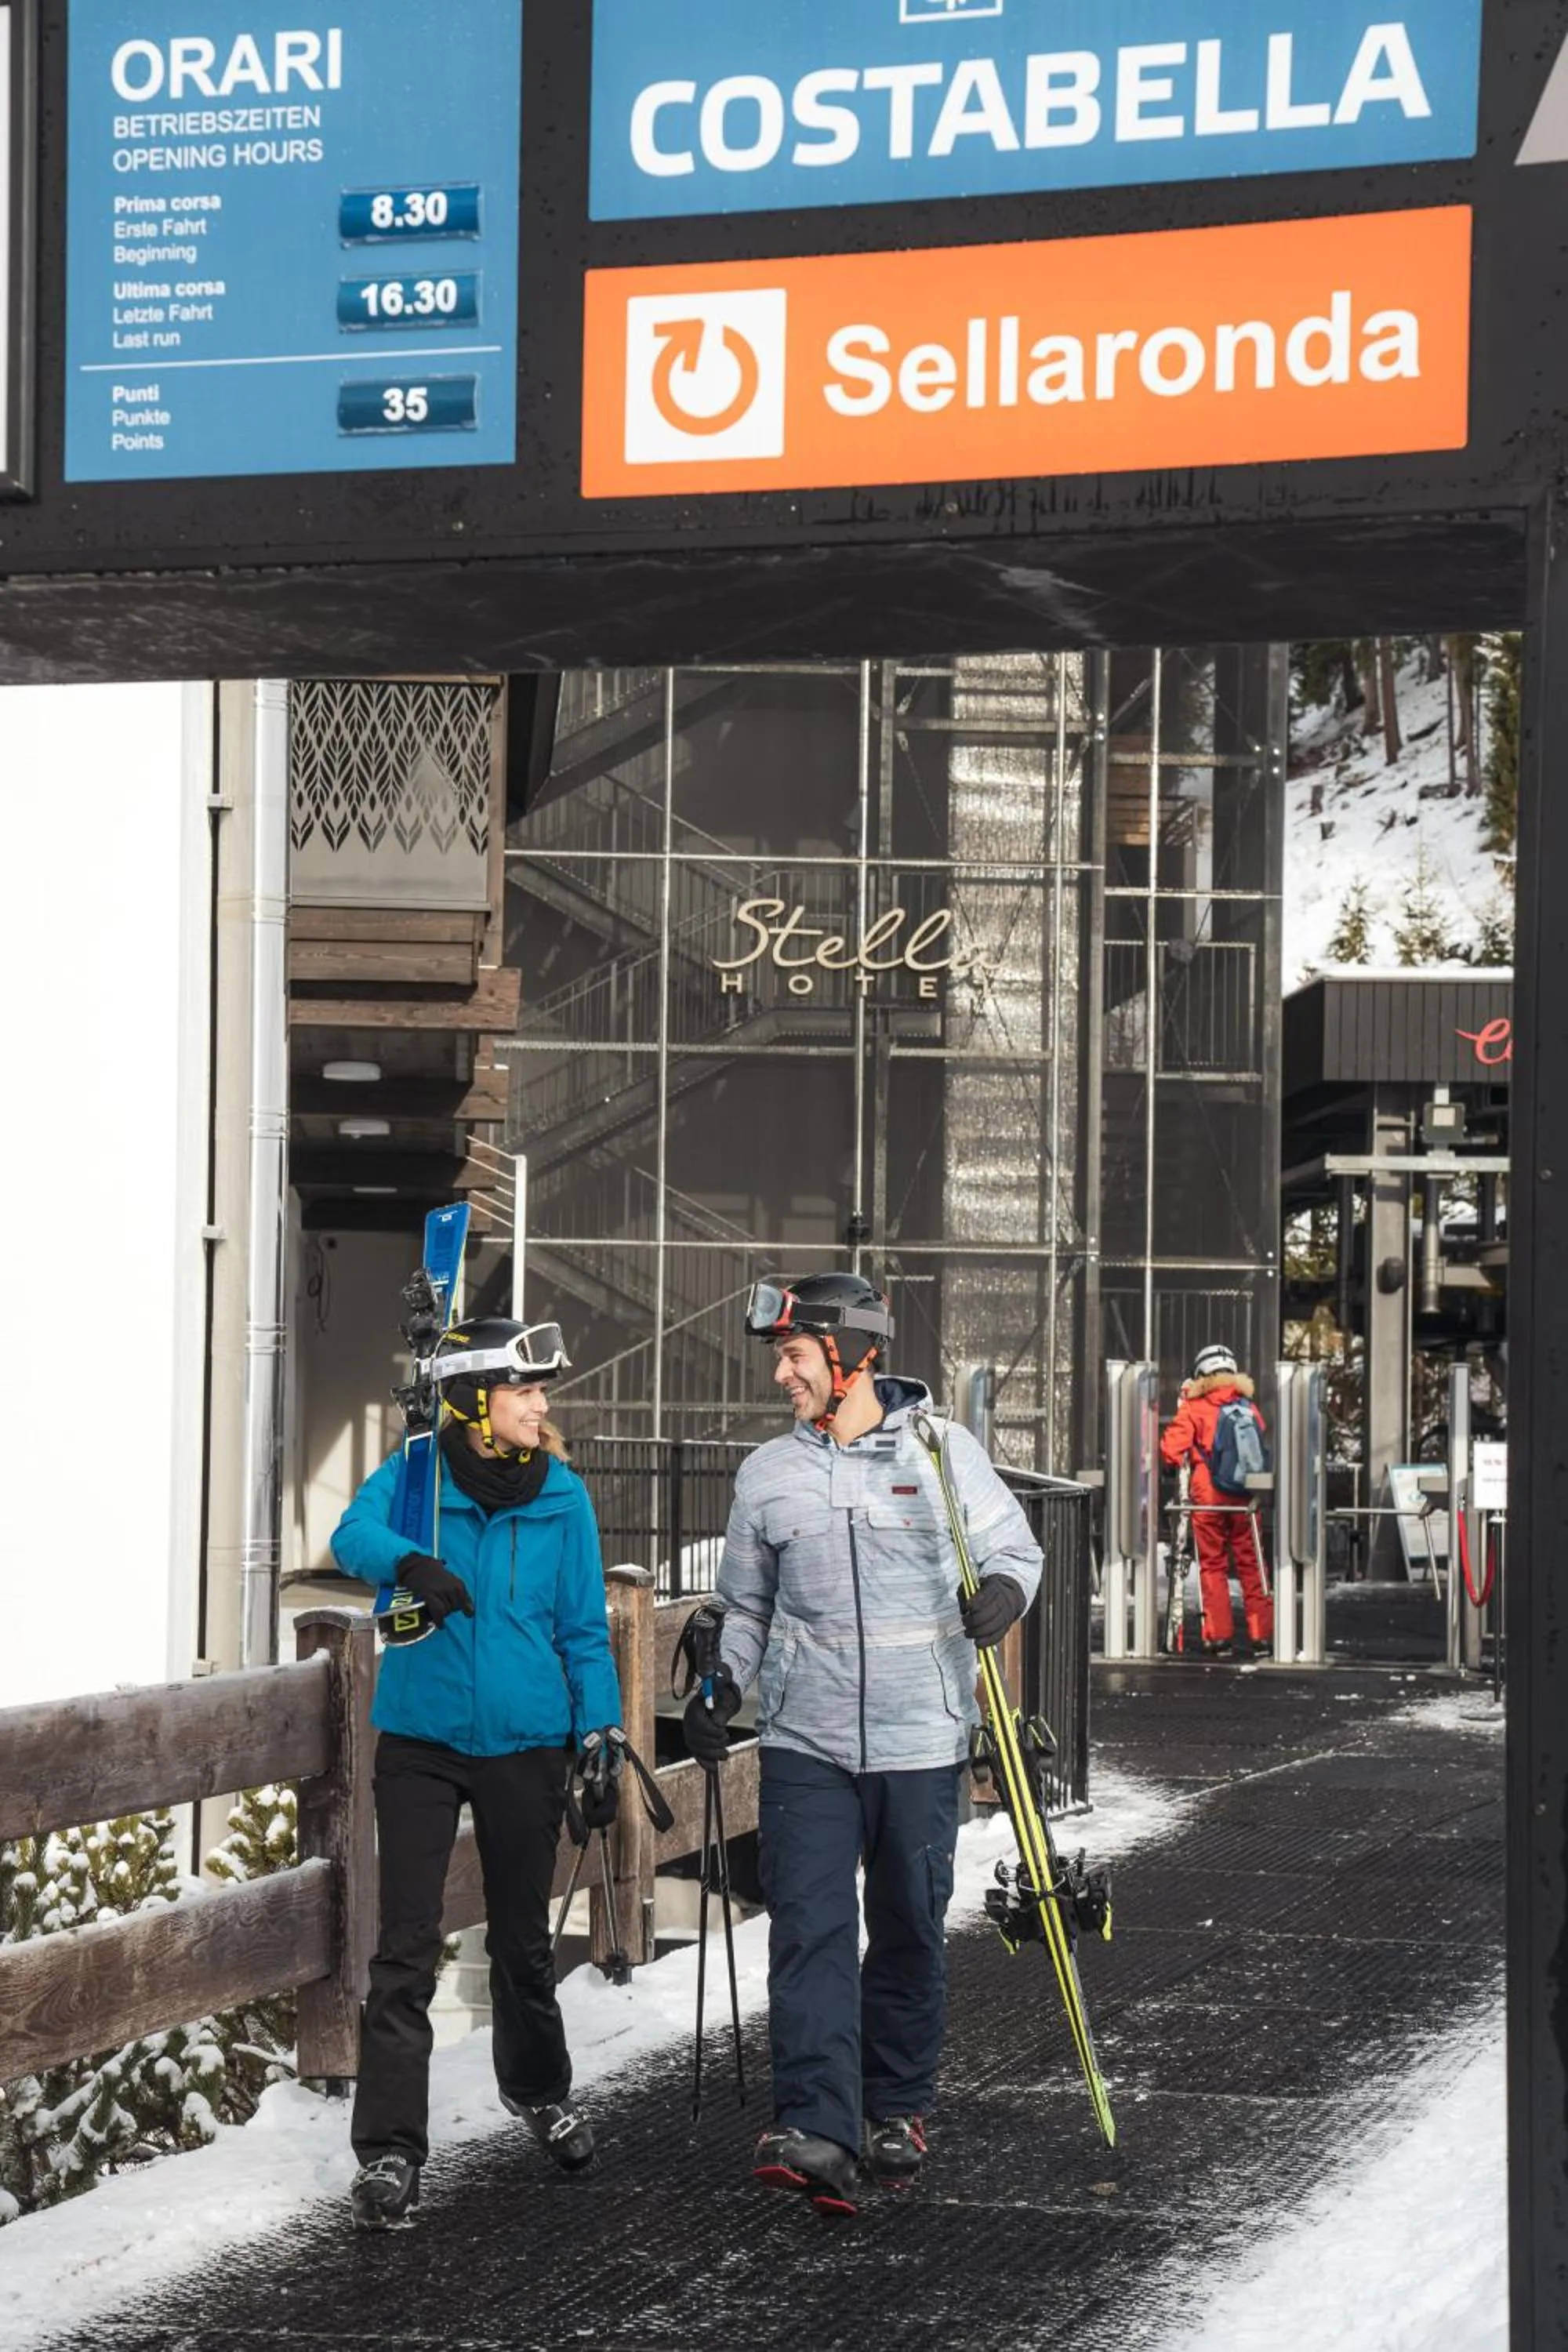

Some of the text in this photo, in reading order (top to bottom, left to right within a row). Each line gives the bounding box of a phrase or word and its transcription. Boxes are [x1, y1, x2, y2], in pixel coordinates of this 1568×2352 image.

[111, 28, 343, 102] ORARI
[630, 22, 1432, 176] COSTABELLA
[113, 106, 321, 139] BETRIEBSZEITEN
[112, 139, 323, 172] OPENING HOURS
[114, 194, 221, 214] Prima corsa
[371, 192, 447, 227] 8.30
[114, 217, 207, 238] Erste Fahrt
[113, 245, 197, 266] Beginning
[113, 279, 226, 299] Ultima corsa
[361, 280, 457, 316] 16.30
[113, 303, 213, 324] Letzte Fahrt
[113, 330, 181, 349] Last run
[822, 290, 1421, 417] Sellaronda
[112, 384, 160, 403] Punti
[383, 387, 428, 422] 35
[112, 408, 171, 426] Punkte
[111, 433, 164, 451] Points
[708, 898, 1008, 971] Stella
